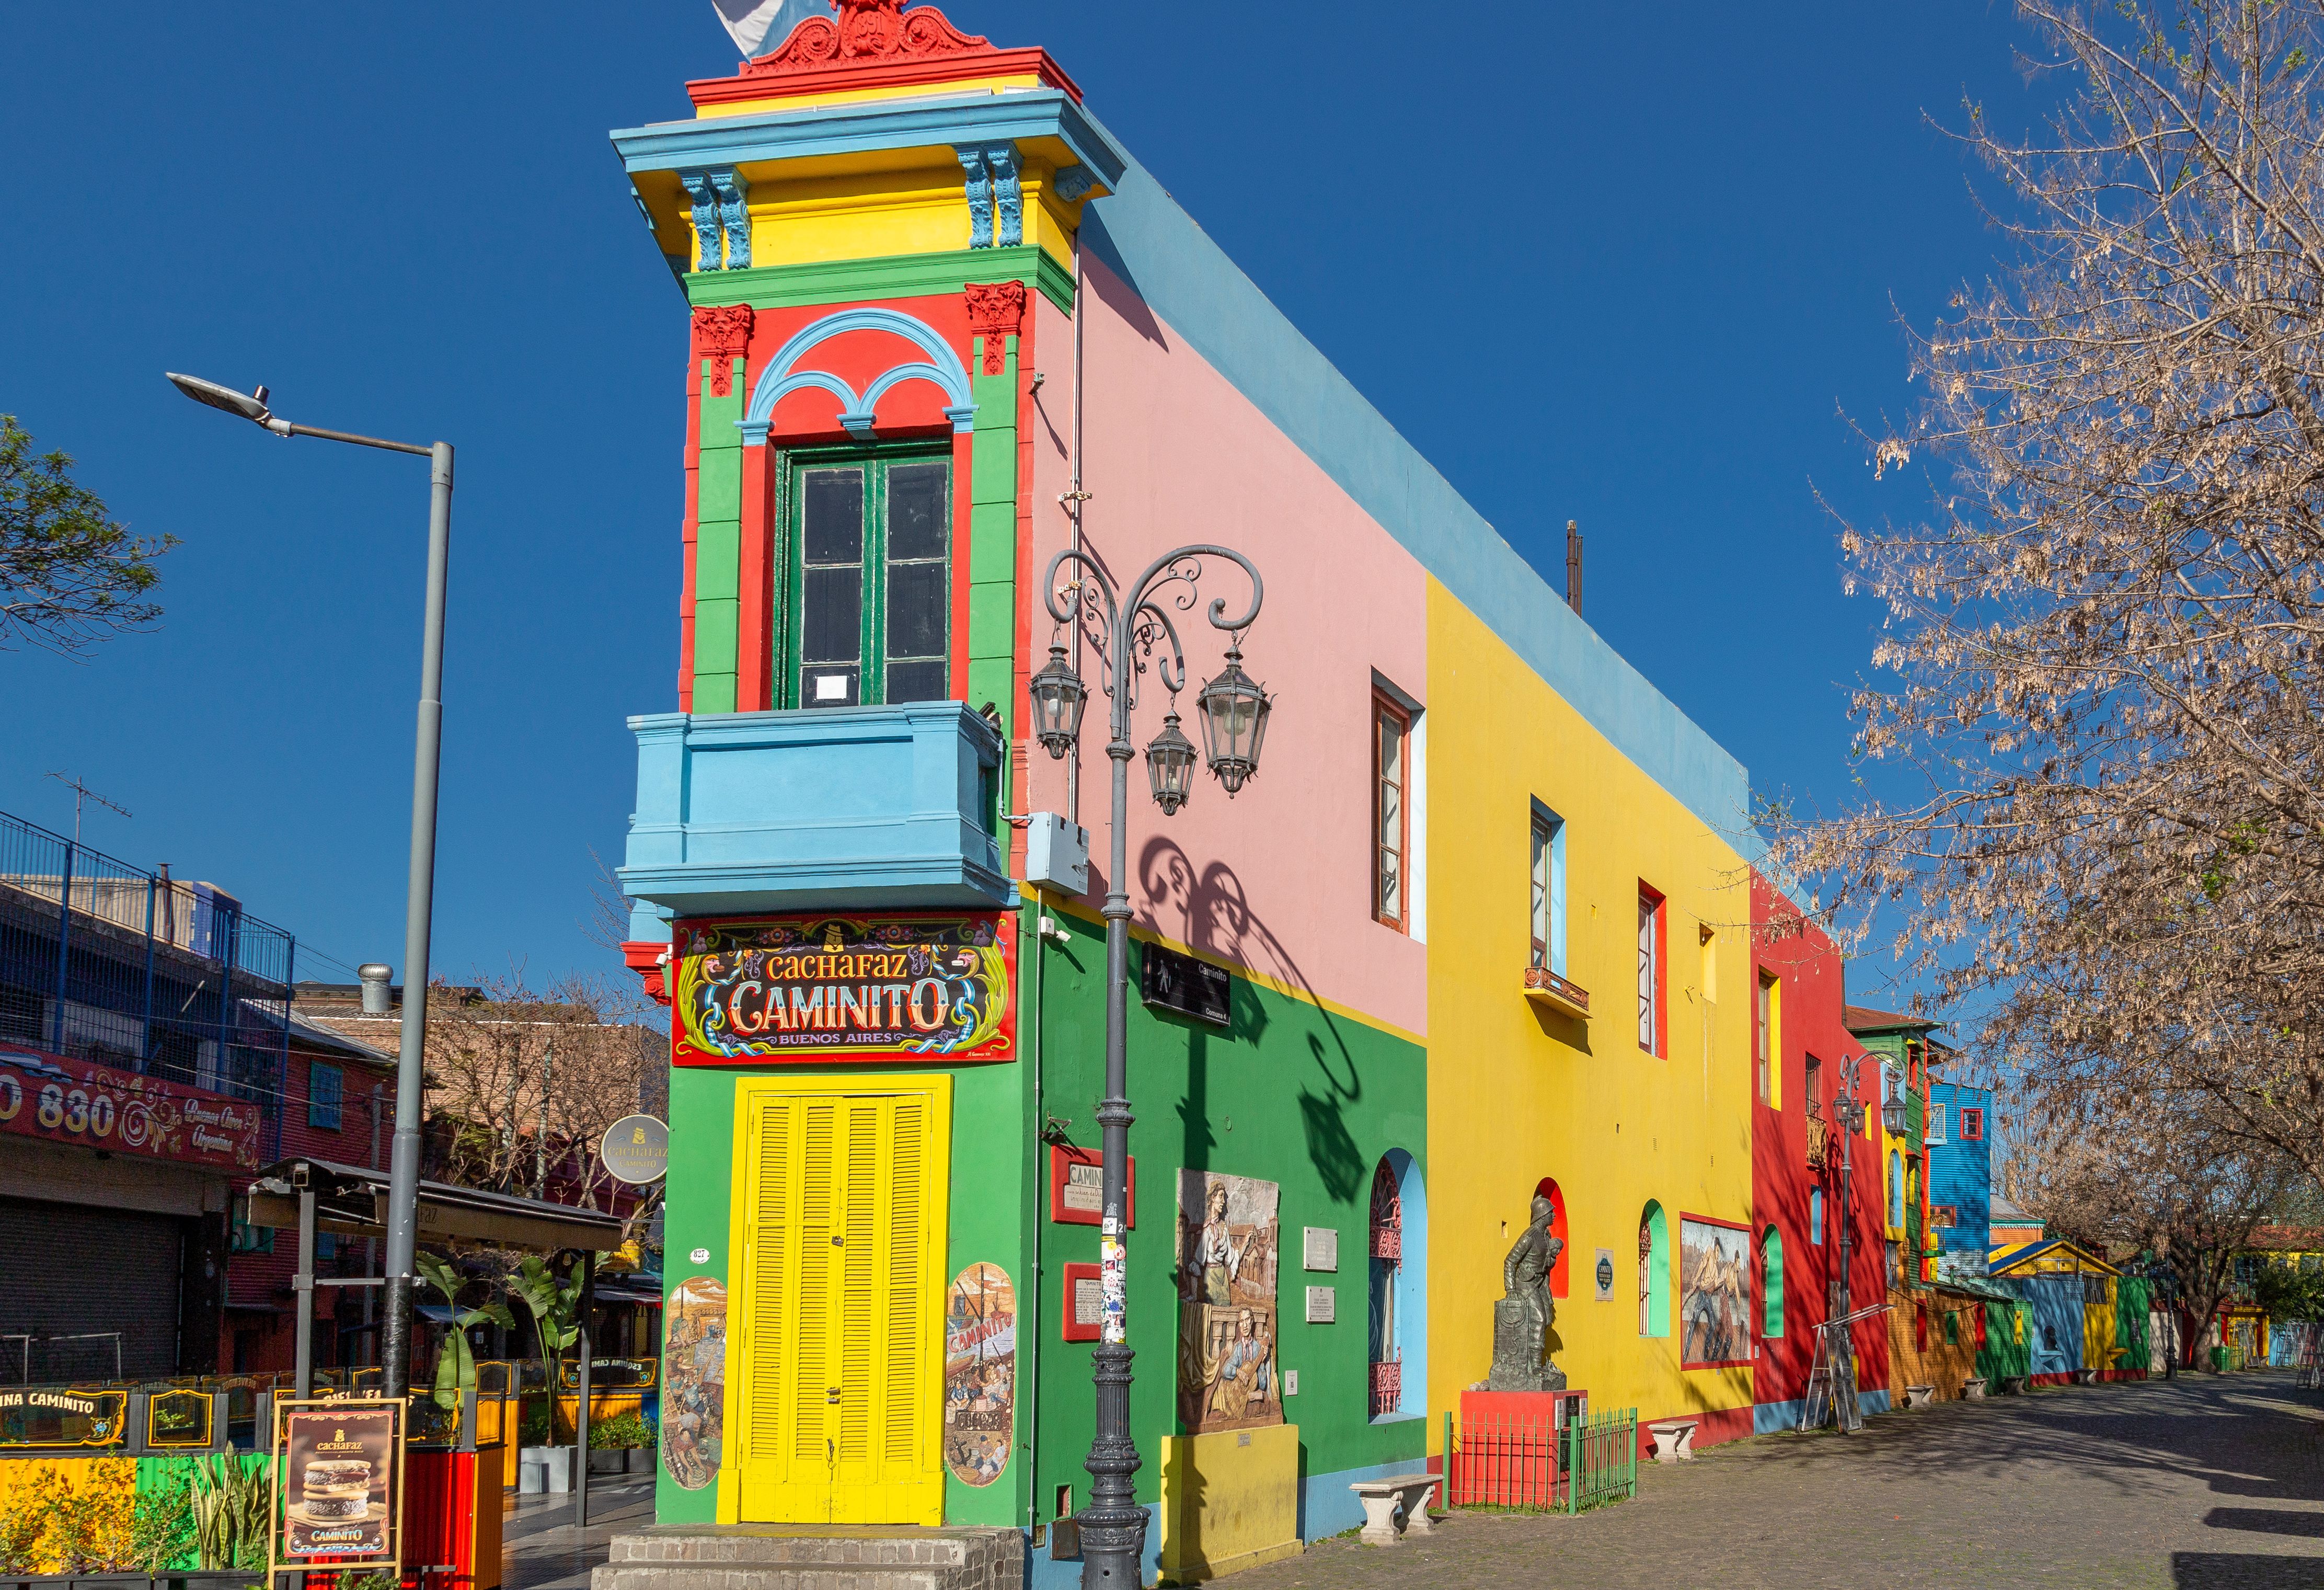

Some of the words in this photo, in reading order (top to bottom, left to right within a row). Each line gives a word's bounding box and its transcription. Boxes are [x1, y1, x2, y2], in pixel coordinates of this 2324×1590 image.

[1199, 963, 1227, 982] Caminito
[728, 978, 949, 1033] CAMINITO
[1206, 1008, 1223, 1019] Comuna
[779, 1034, 840, 1045] BUENOS
[844, 1033, 892, 1044] AIRES
[39, 1084, 114, 1137] 830
[619, 1159, 657, 1168] CAMINITO
[949, 1312, 1012, 1353] CAMINITO
[28, 1393, 95, 1414] CAMINITO
[310, 1529, 363, 1542] CAMINITO
